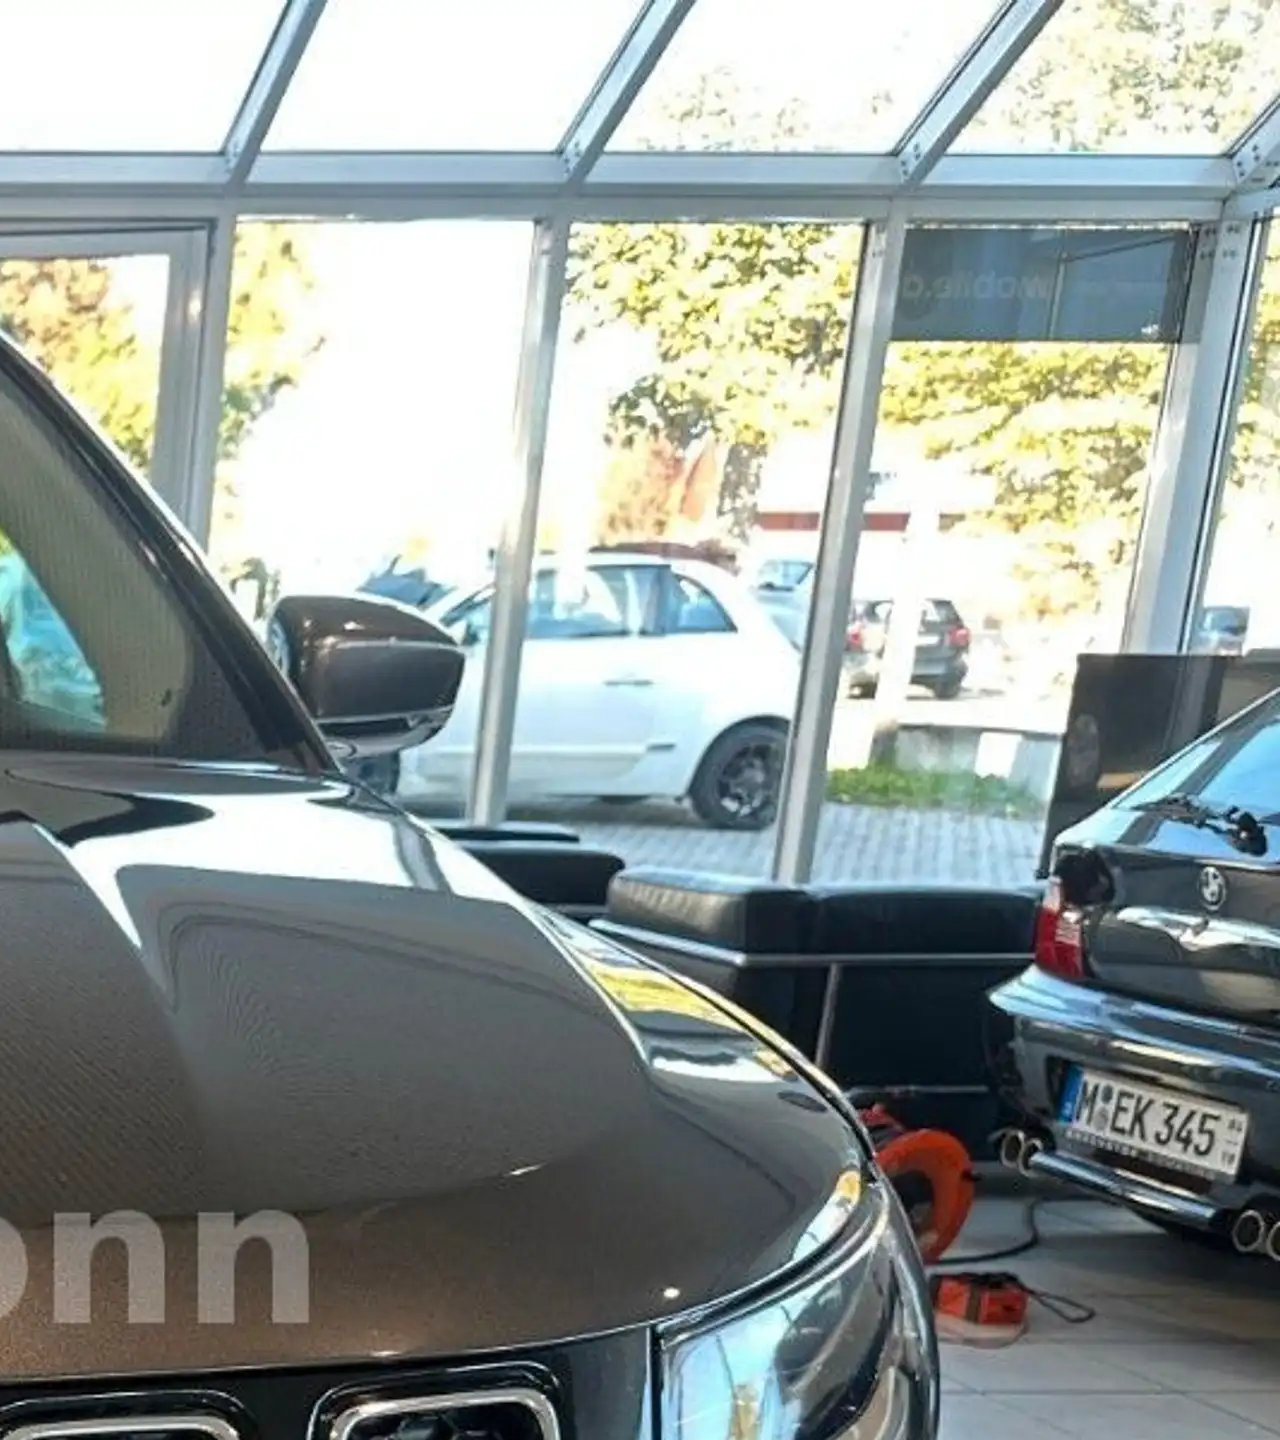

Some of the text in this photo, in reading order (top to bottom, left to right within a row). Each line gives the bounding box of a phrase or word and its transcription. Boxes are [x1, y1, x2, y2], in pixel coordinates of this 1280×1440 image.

[1074, 1080, 1100, 1126] M
[1109, 1088, 1156, 1143] EK
[1154, 1102, 1222, 1157] 345
